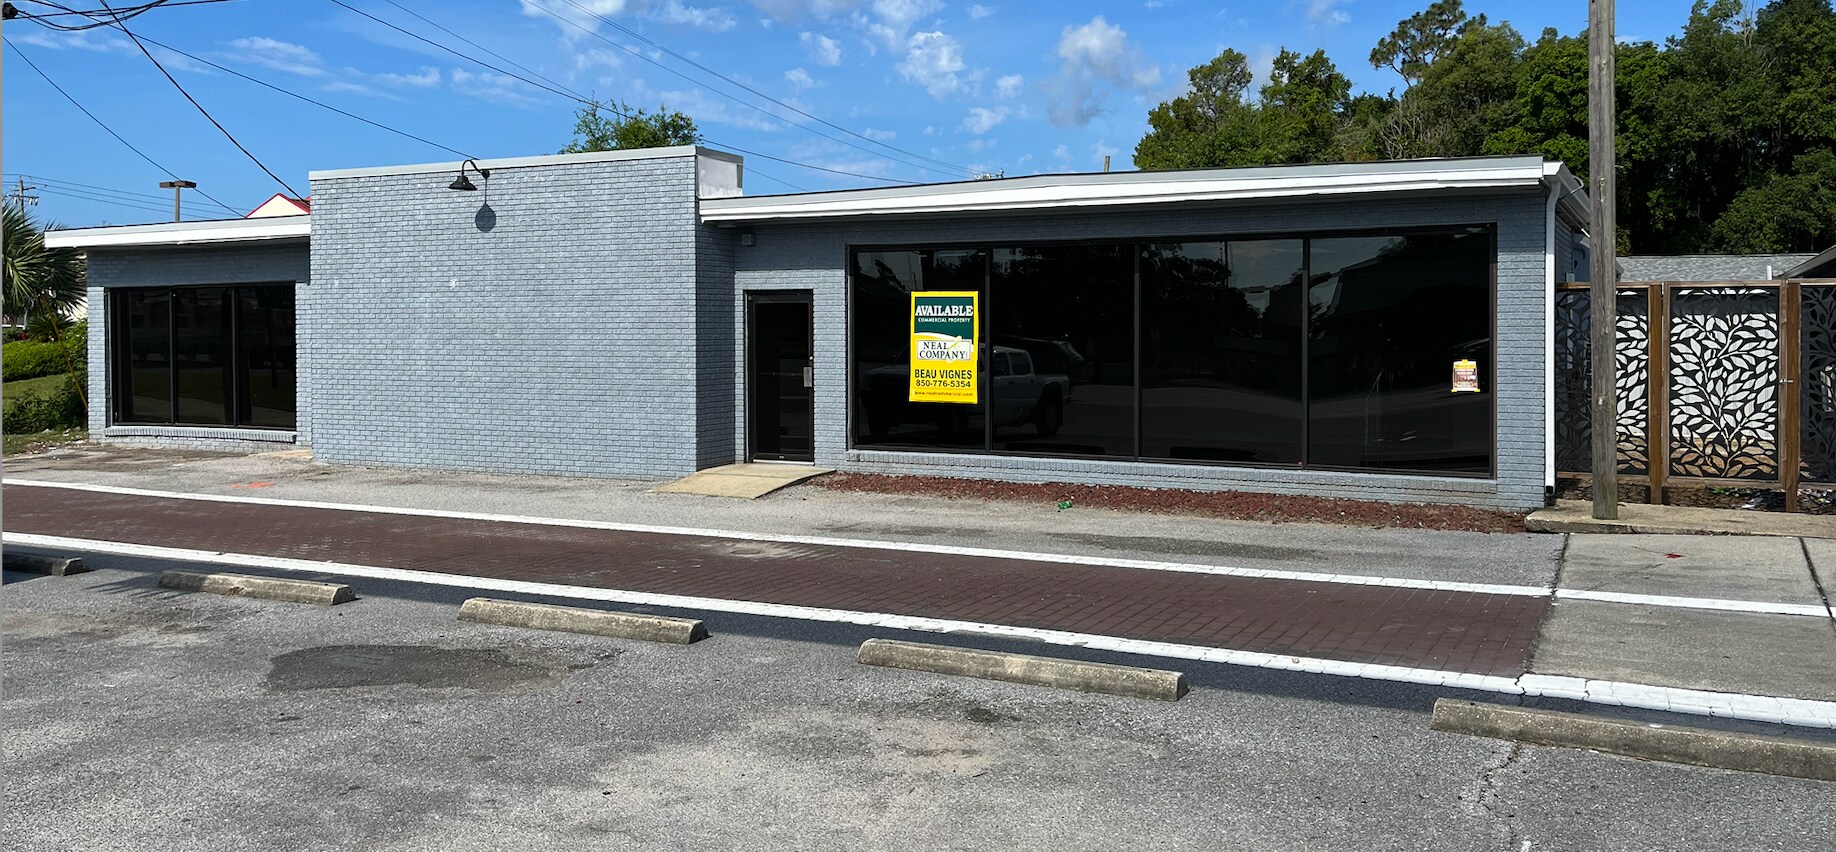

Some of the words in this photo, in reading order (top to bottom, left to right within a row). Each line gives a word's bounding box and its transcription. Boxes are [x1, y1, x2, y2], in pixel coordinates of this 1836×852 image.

[915, 305, 974, 316] AVAILABLE
[923, 341, 949, 350] NEAL
[919, 350, 966, 359] COMPANY
[914, 368, 937, 379] BEAU
[939, 369, 973, 380] VIGNES
[915, 379, 972, 388] 850-776-5354
